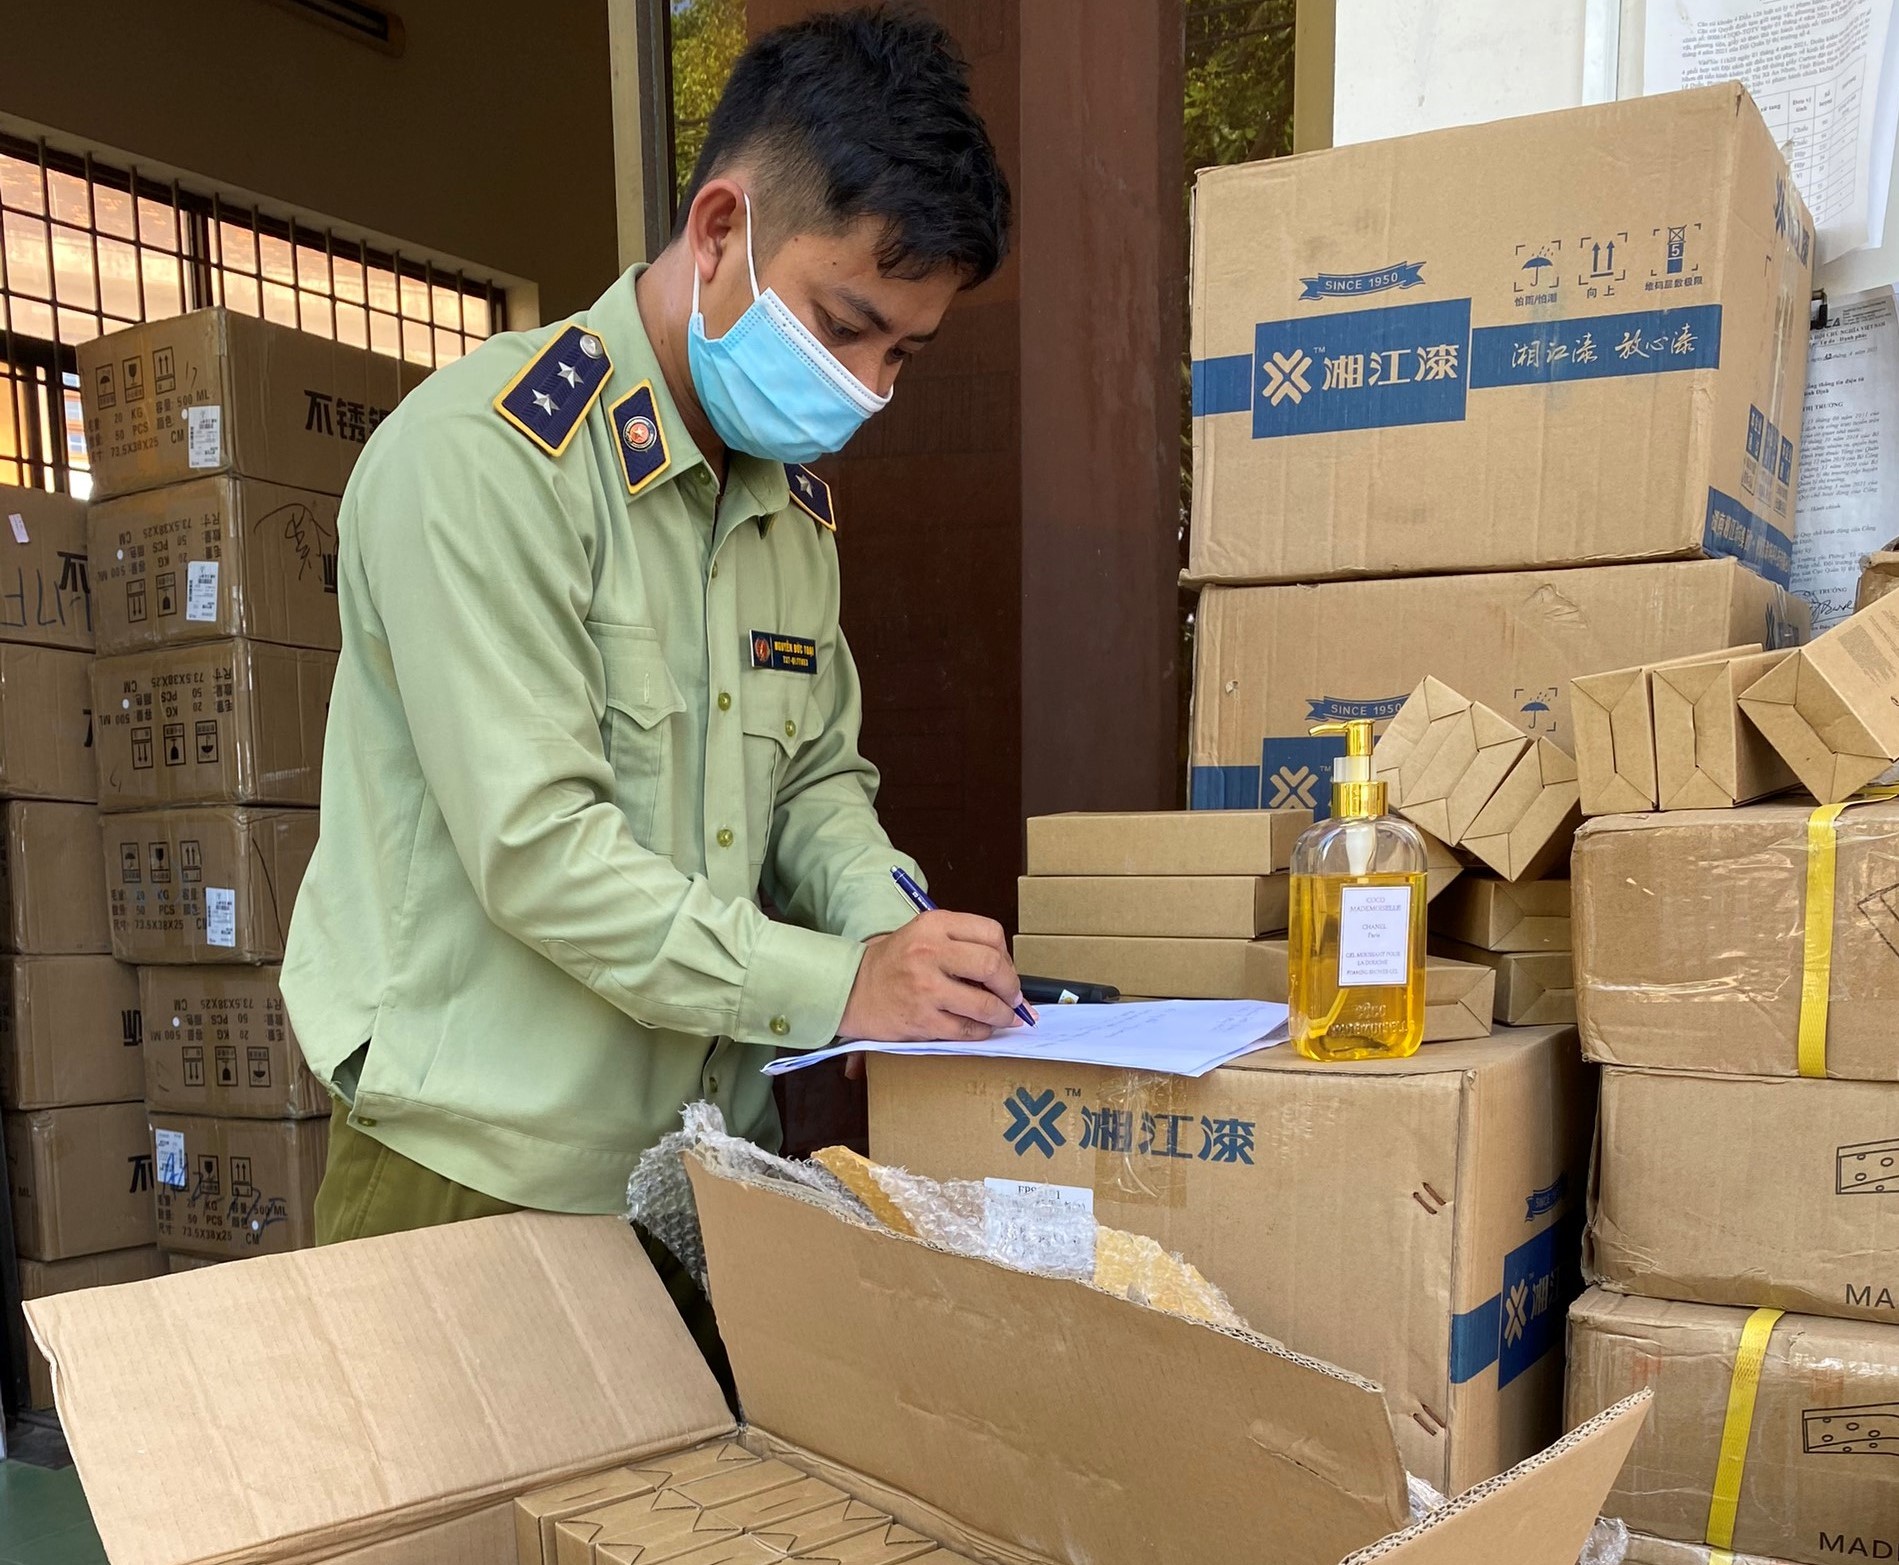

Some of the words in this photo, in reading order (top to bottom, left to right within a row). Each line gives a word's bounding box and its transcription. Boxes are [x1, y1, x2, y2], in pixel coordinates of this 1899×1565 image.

[1671, 244, 1681, 257] 5
[1325, 279, 1362, 291] SINCE
[1369, 271, 1399, 288] 1950
[1322, 344, 1459, 391] 湘江漆
[131, 407, 144, 419] KG
[177, 394, 193, 407] 500
[196, 390, 210, 402] ML
[132, 422, 149, 436] PCS
[170, 428, 184, 444] CM
[119, 531, 132, 546] CM
[152, 538, 168, 554] PCS
[157, 556, 169, 568] KG
[123, 680, 137, 693] CM
[192, 687, 202, 698] 50
[161, 690, 178, 703] PCS
[166, 706, 178, 719] KG
[192, 701, 202, 713] 20
[1331, 704, 1368, 715] SINCE
[1372, 703, 1401, 715] 1950
[99, 714, 111, 726] ML
[115, 713, 130, 725] 500
[158, 888, 169, 901] KG
[136, 904, 145, 915] 50
[158, 904, 175, 916] PCS
[135, 919, 184, 931] 73.5X38X25
[173, 998, 188, 1011] CM
[200, 998, 254, 1010] 73.5X38X25
[211, 1014, 228, 1026] PCS
[164, 1030, 180, 1041] 500
[216, 1029, 229, 1041] KG
[240, 1030, 249, 1040] 20
[1065, 1087, 1082, 1098] TM
[1079, 1105, 1256, 1165] 湘江漆
[205, 1200, 218, 1211] KG
[274, 1205, 288, 1217] ML
[188, 1214, 198, 1224] 50
[206, 1216, 223, 1226] PCS
[182, 1225, 232, 1241] 73.5X38X25
[245, 1233, 259, 1245] CM
[1819, 1531, 1899, 1561] MAD
